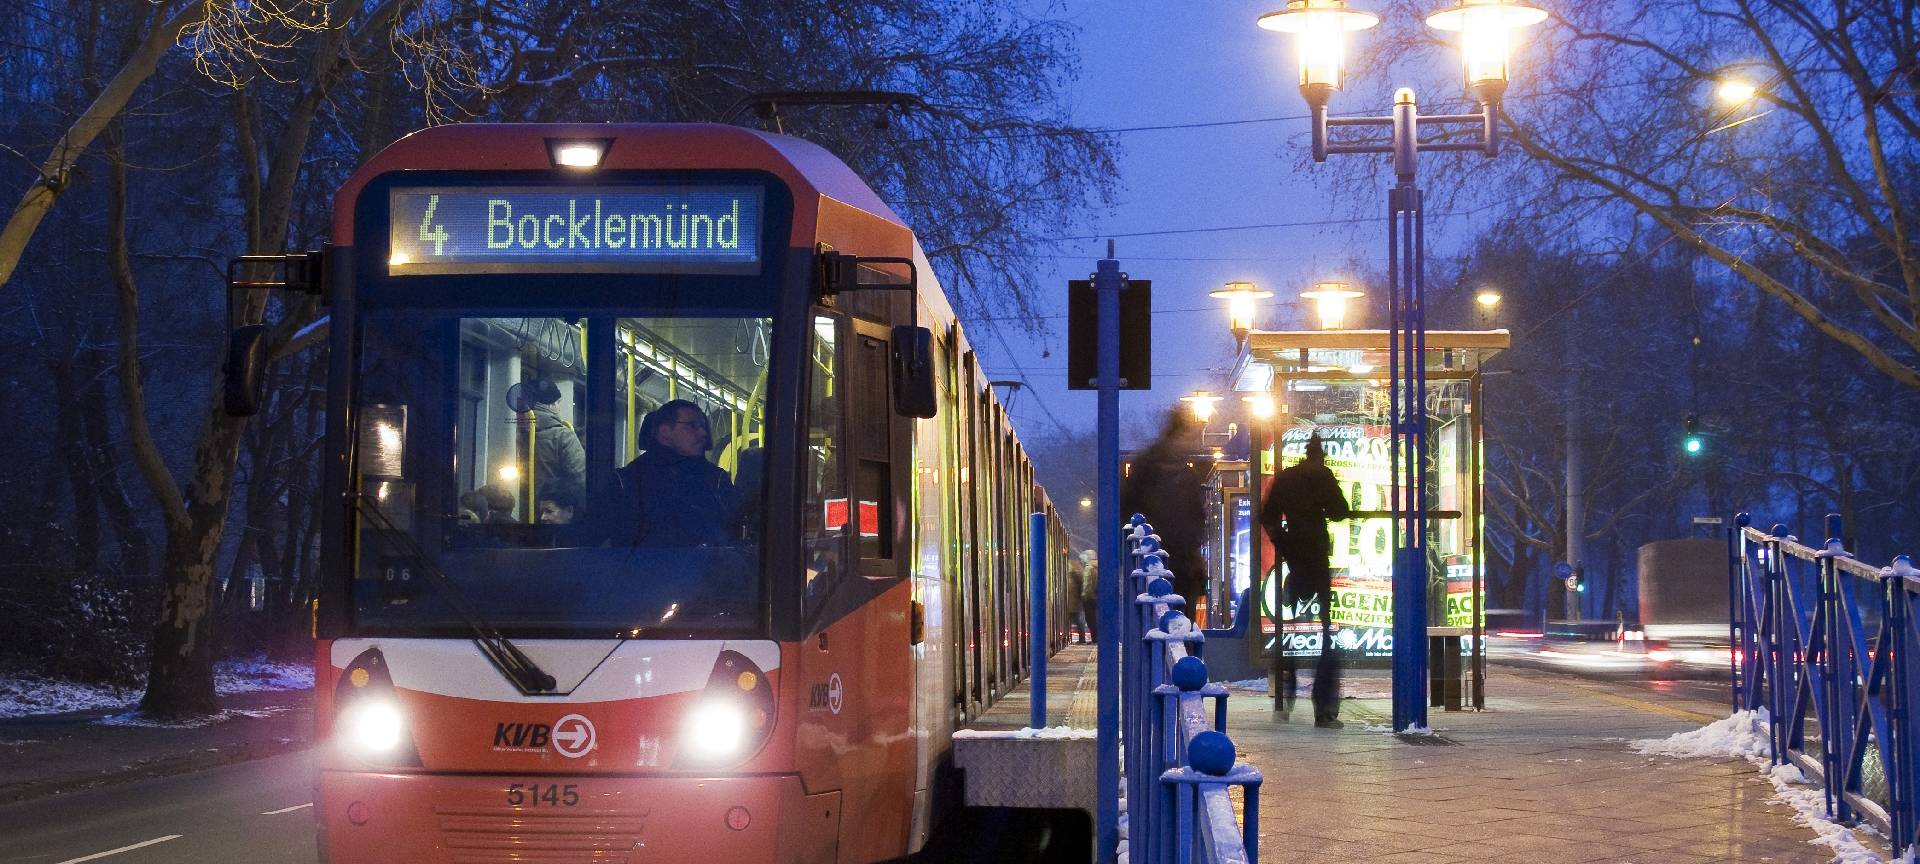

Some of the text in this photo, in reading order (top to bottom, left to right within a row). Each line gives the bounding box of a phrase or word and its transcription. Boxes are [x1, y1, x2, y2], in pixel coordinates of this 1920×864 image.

[419, 194, 739, 257] 4 Bocklemünd
[1329, 590, 1393, 612] AGEN
[1329, 607, 1393, 626] INANZIER
[493, 723, 551, 748] KVB
[507, 783, 579, 807] 5145
